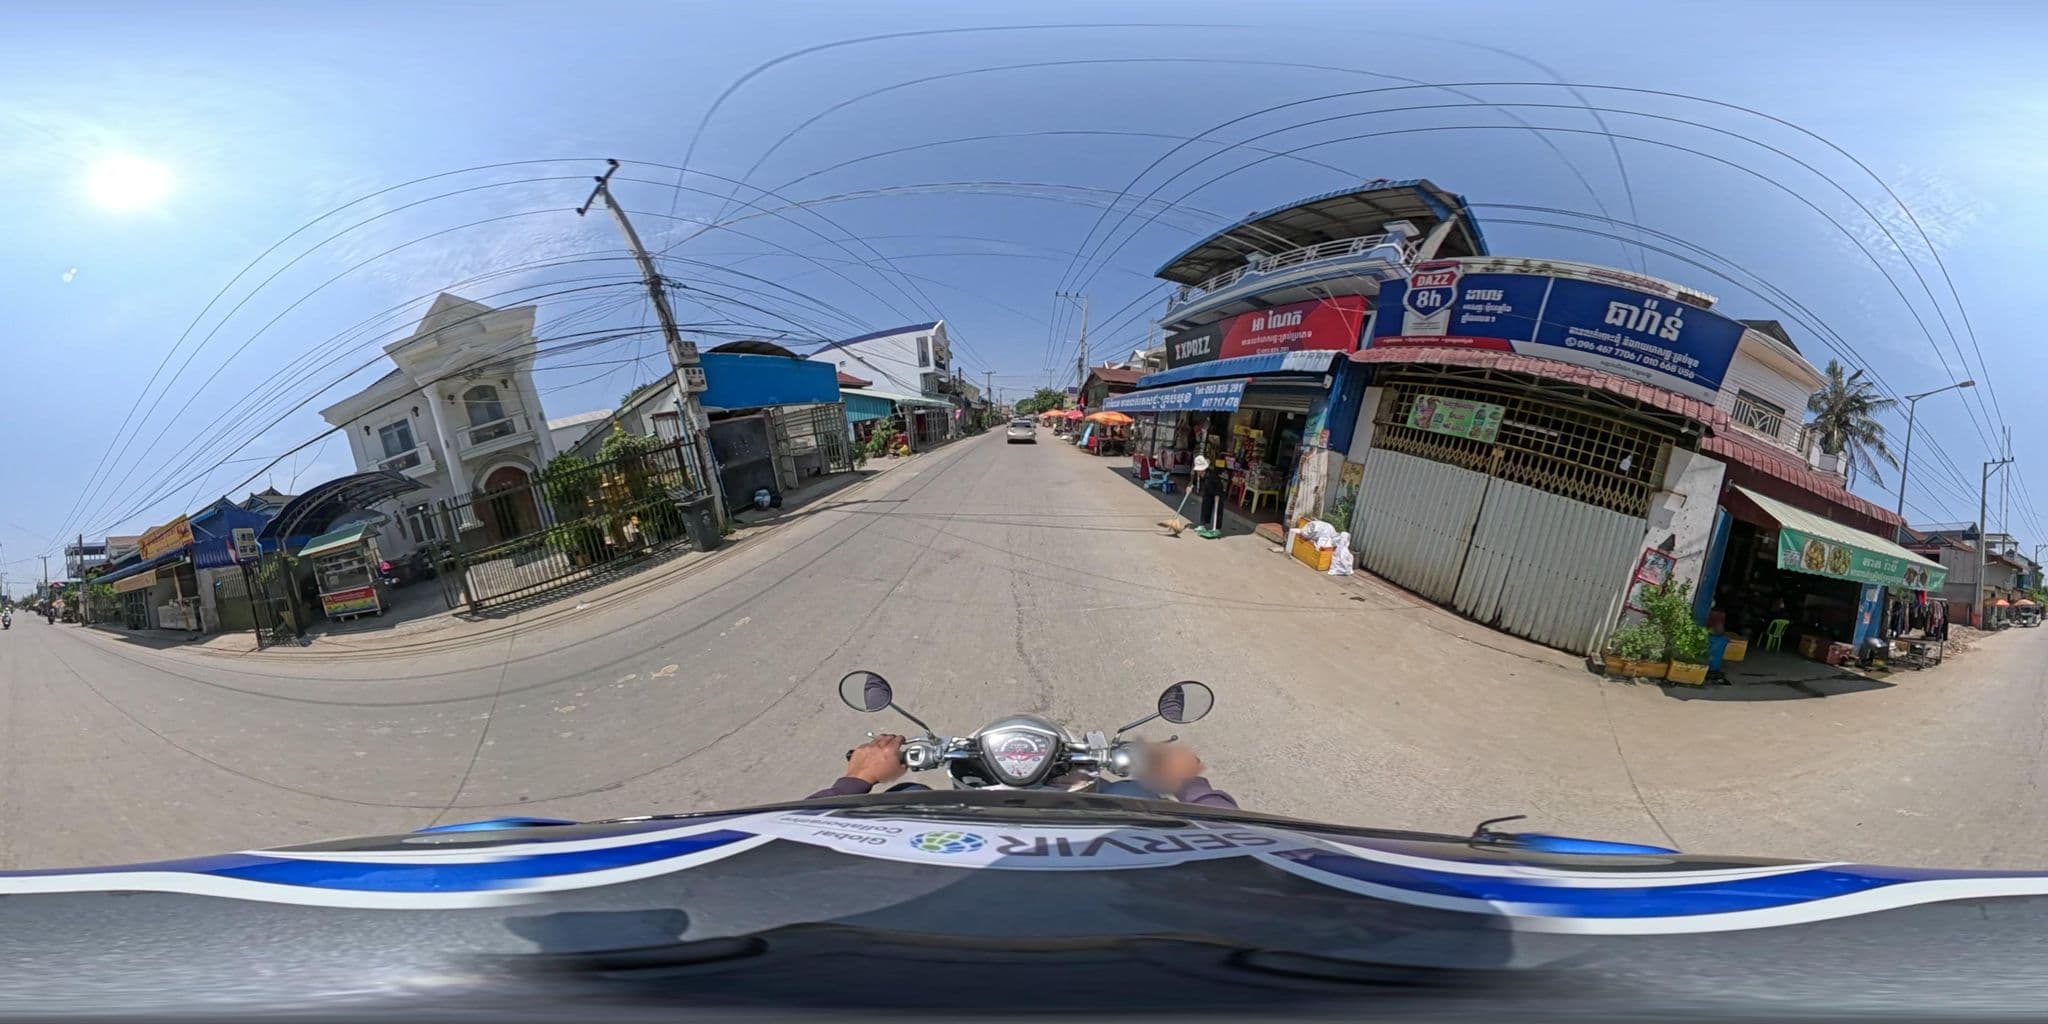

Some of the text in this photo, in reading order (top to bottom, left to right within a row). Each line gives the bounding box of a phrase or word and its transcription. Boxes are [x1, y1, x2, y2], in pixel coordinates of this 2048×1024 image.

[1416, 273, 1451, 287] DAZZ
[1416, 289, 1442, 309] 8h
[1596, 343, 1614, 355] 467
[1614, 347, 1636, 360] 7706
[811, 830, 887, 845] Global
[997, 832, 1277, 857] SERVIR
